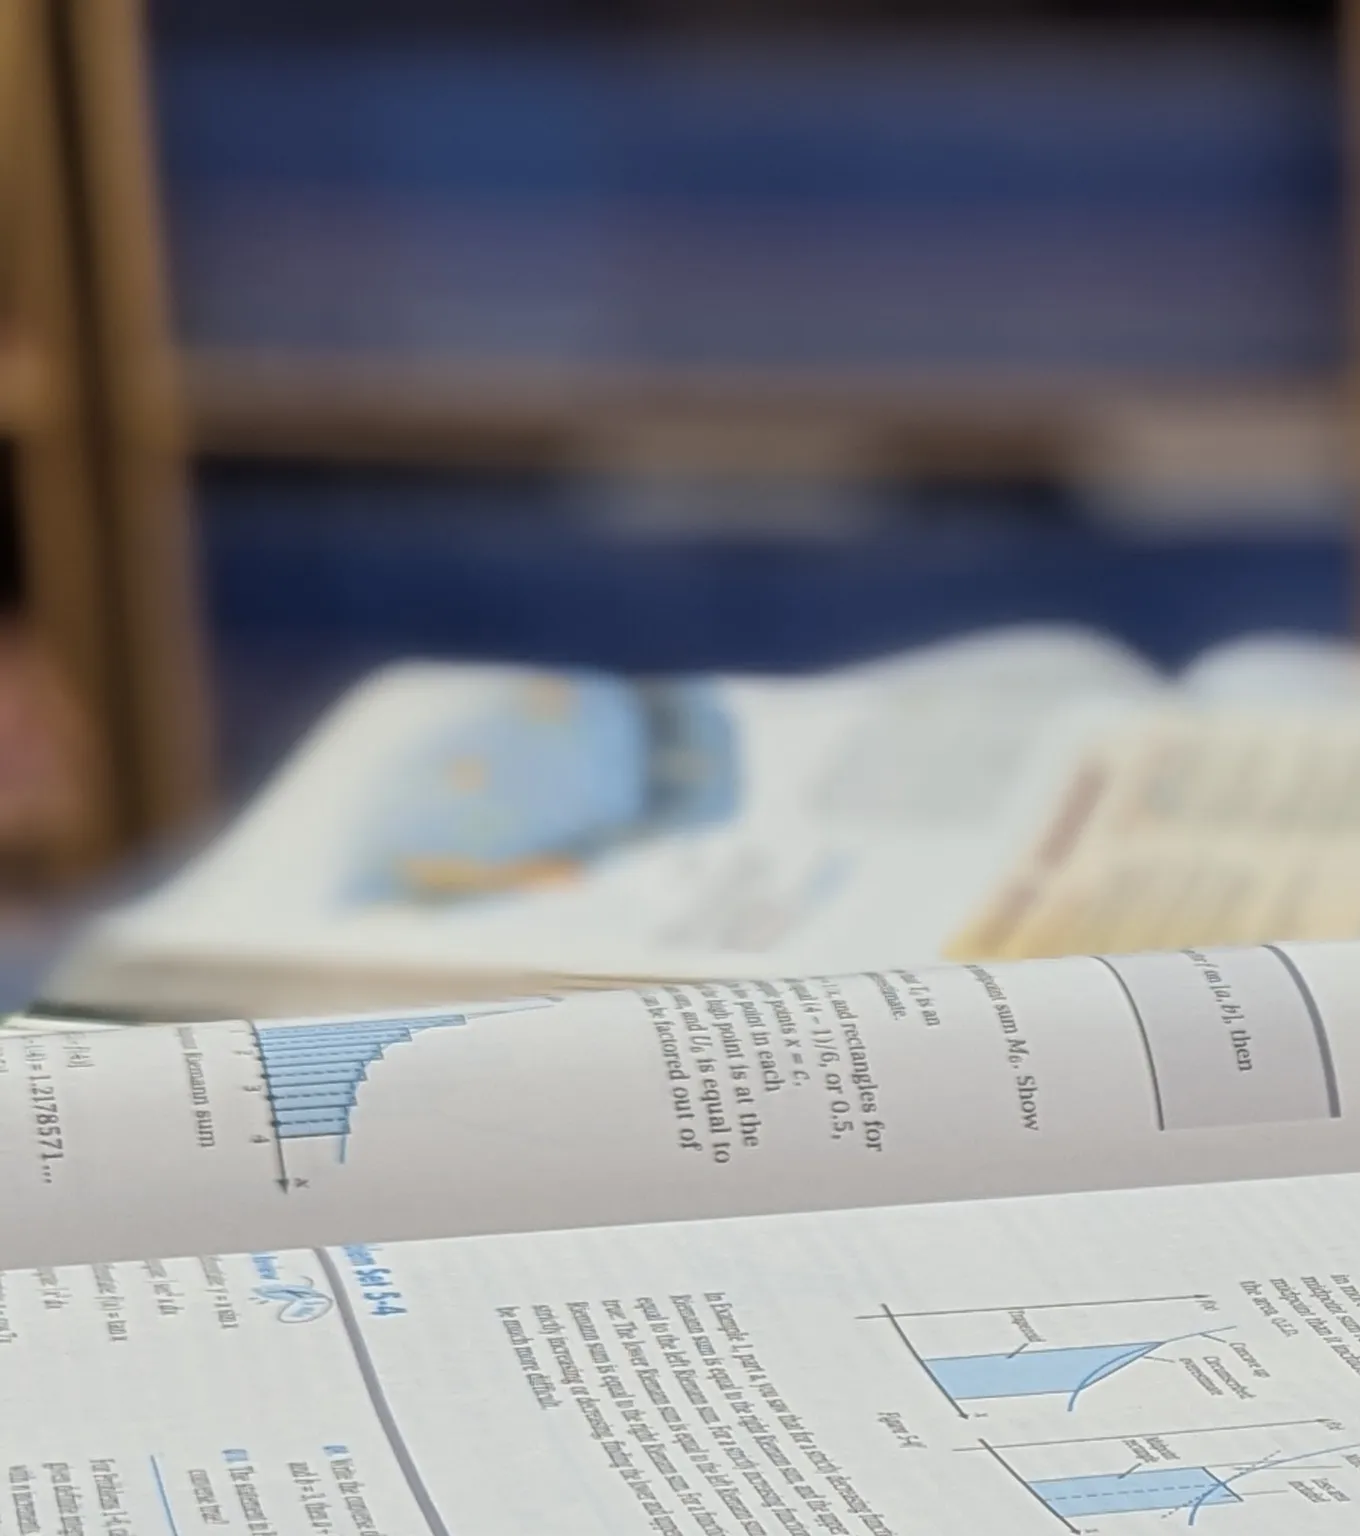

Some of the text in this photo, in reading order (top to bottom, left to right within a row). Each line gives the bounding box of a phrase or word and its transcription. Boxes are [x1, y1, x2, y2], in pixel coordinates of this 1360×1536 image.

[763, 1000, 801, 1048] points x
[920, 1007, 942, 1028] an
[733, 1001, 785, 1092] point in each
[994, 1004, 1019, 1035] sum
[1015, 1074, 1040, 1132] Show
[1229, 1029, 1252, 1072] then
[653, 1020, 703, 1151] factored out of
[681, 1011, 732, 1164] and is equal to
[712, 1022, 762, 1147] point is at the
[825, 1073, 854, 1140] or 0.5,
[840, 1022, 879, 1113] rectangles
[863, 1119, 886, 1152] for
[195, 1110, 216, 1149] sum
[352, 1268, 394, 1287] Set
[501, 1319, 535, 1346] much
[613, 1321, 650, 1367] The lower
[514, 1346, 541, 1372] more
[547, 1337, 584, 1384] increasing
